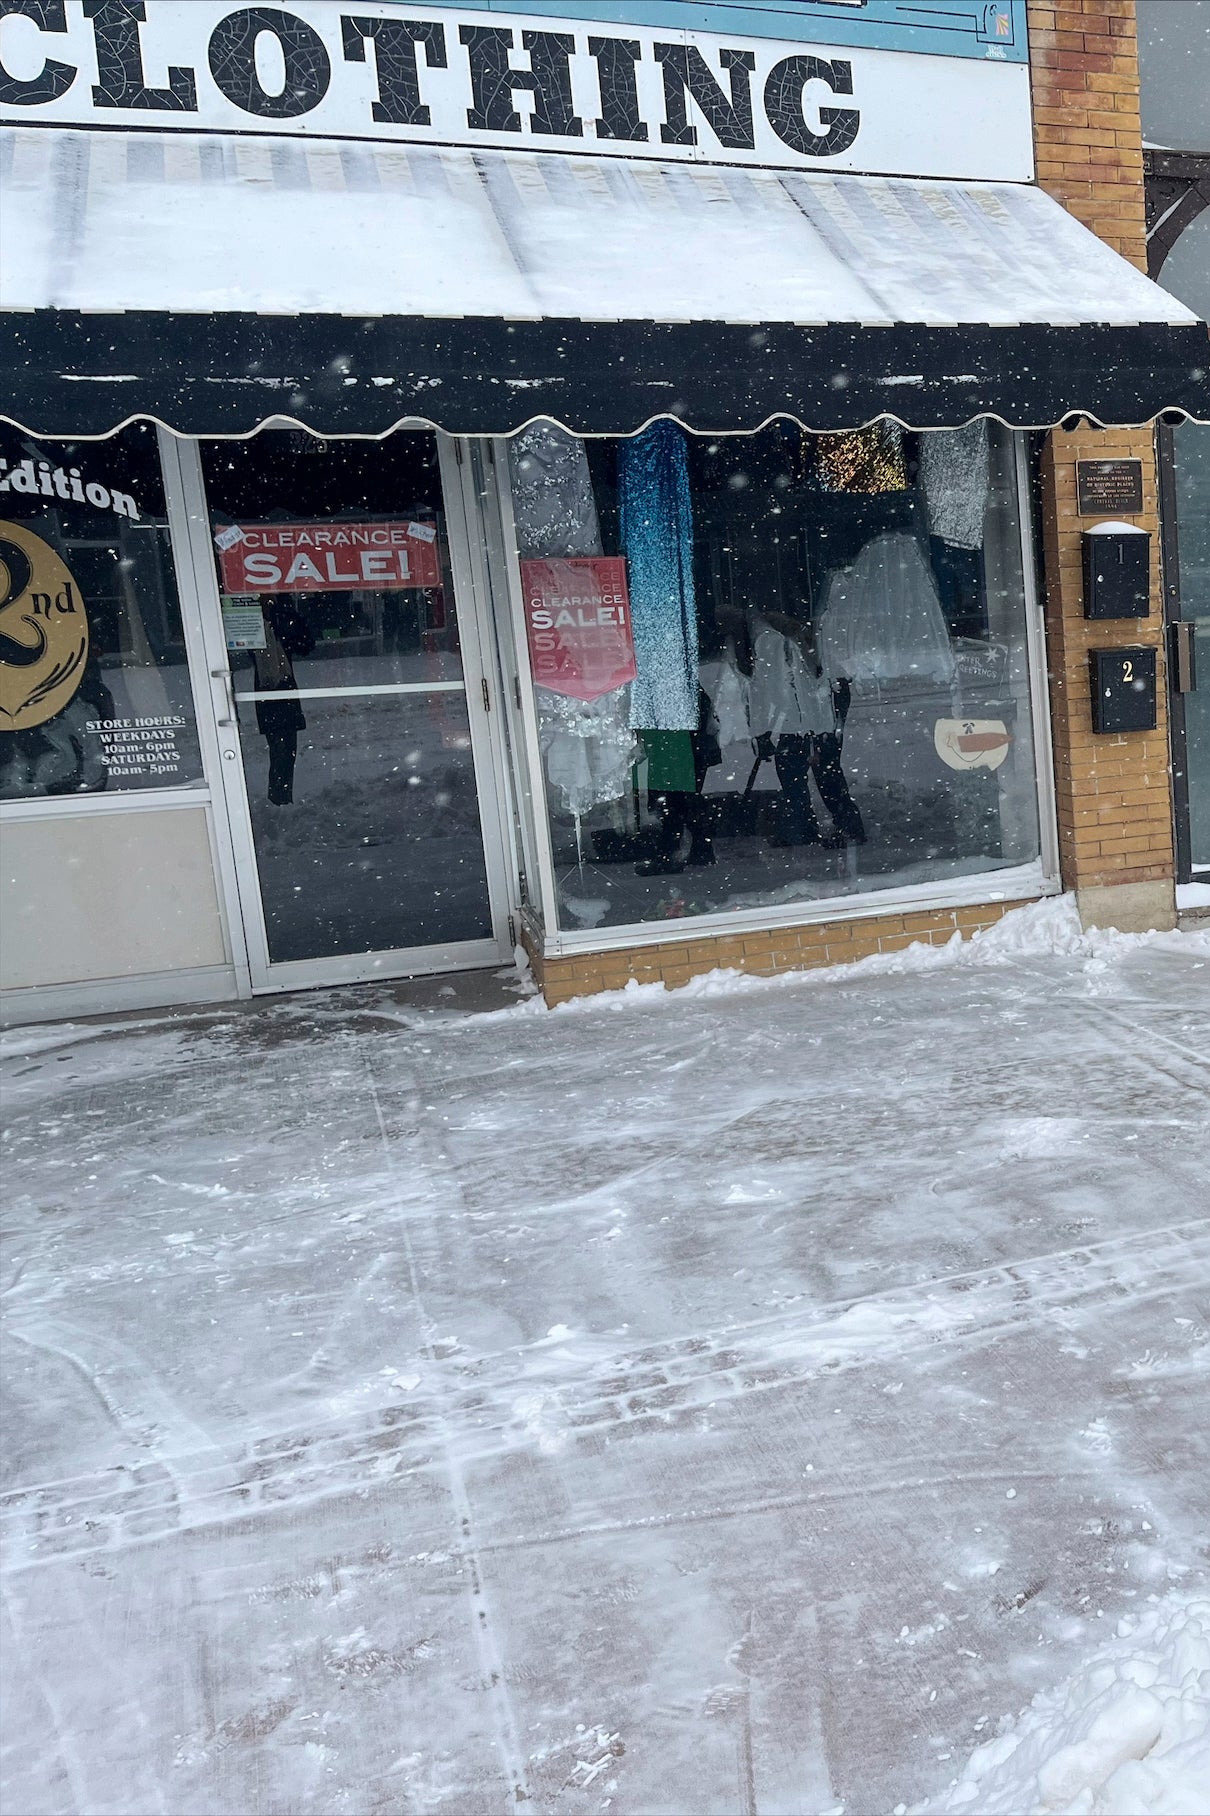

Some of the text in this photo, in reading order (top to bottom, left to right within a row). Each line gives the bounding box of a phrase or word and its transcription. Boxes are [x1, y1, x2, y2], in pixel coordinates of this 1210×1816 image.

[0, 0, 860, 157] CLOTHING
[242, 529, 407, 549] CLEARANCE
[1117, 543, 1125, 565] 1
[243, 550, 411, 586] SALE!
[531, 594, 624, 609] CLEARANCE
[531, 606, 626, 630] SALE!
[1122, 660, 1134, 683] 2
[85, 715, 186, 731] STORE HOURS:
[100, 729, 176, 743] WEEKDAYS
[104, 741, 175, 754] 10am- 6pm
[101, 751, 181, 766] SATURDAYS
[107, 763, 178, 777] 10am- 5pm
